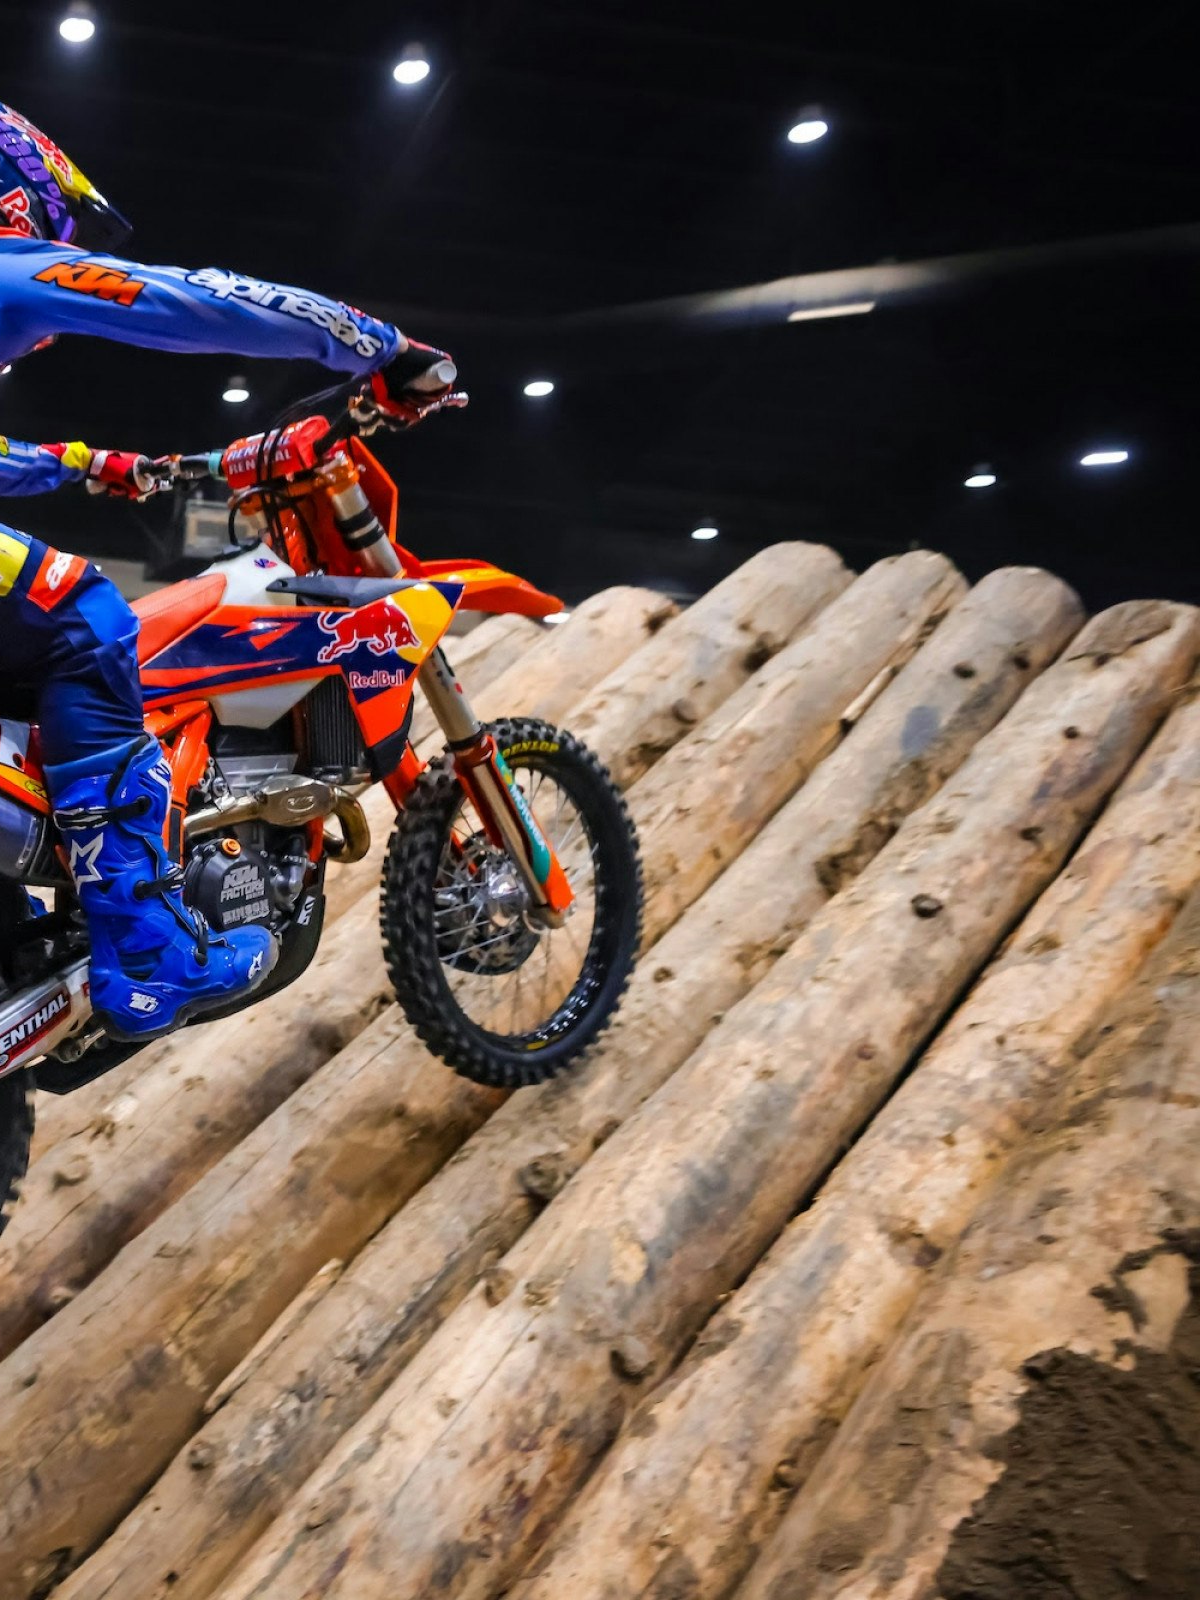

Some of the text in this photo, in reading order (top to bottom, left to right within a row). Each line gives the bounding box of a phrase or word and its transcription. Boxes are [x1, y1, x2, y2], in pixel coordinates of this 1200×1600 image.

[33, 261, 145, 306] KTM
[350, 669, 406, 689] Red Bull
[502, 741, 560, 758] DUNLOP
[223, 864, 259, 890] KTM
[221, 877, 265, 904] FACTORY
